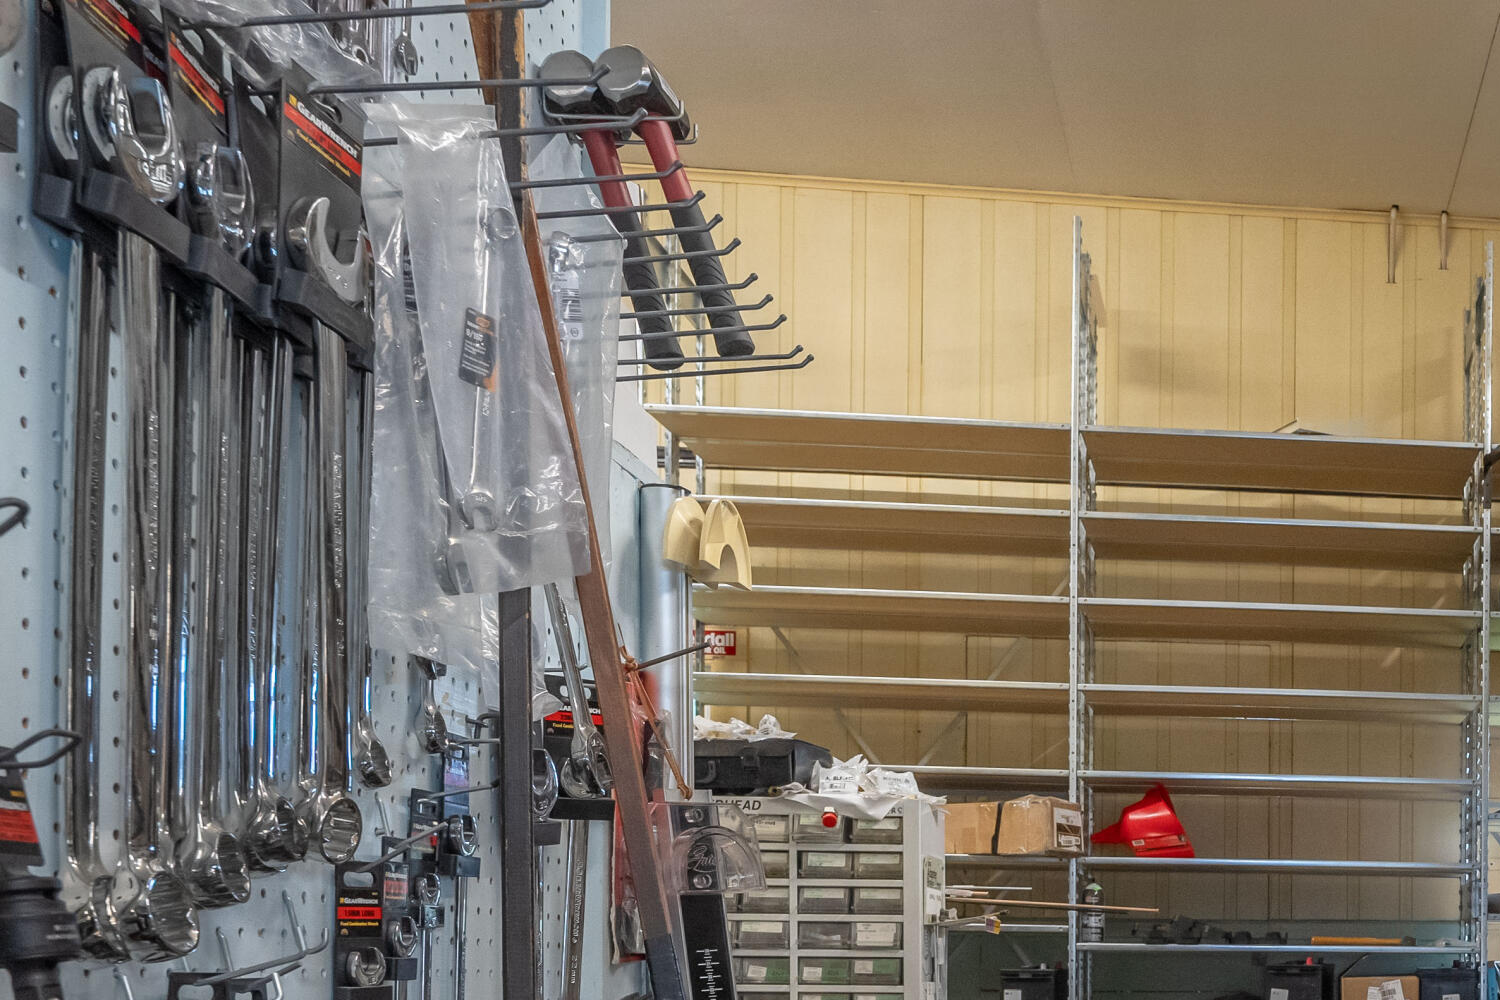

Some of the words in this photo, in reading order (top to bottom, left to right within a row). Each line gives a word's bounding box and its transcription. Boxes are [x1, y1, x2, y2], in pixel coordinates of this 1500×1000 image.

[297, 102, 359, 159] GEARWRENCH
[713, 646, 726, 655] OIL
[344, 897, 378, 905] GEARWRENCH
